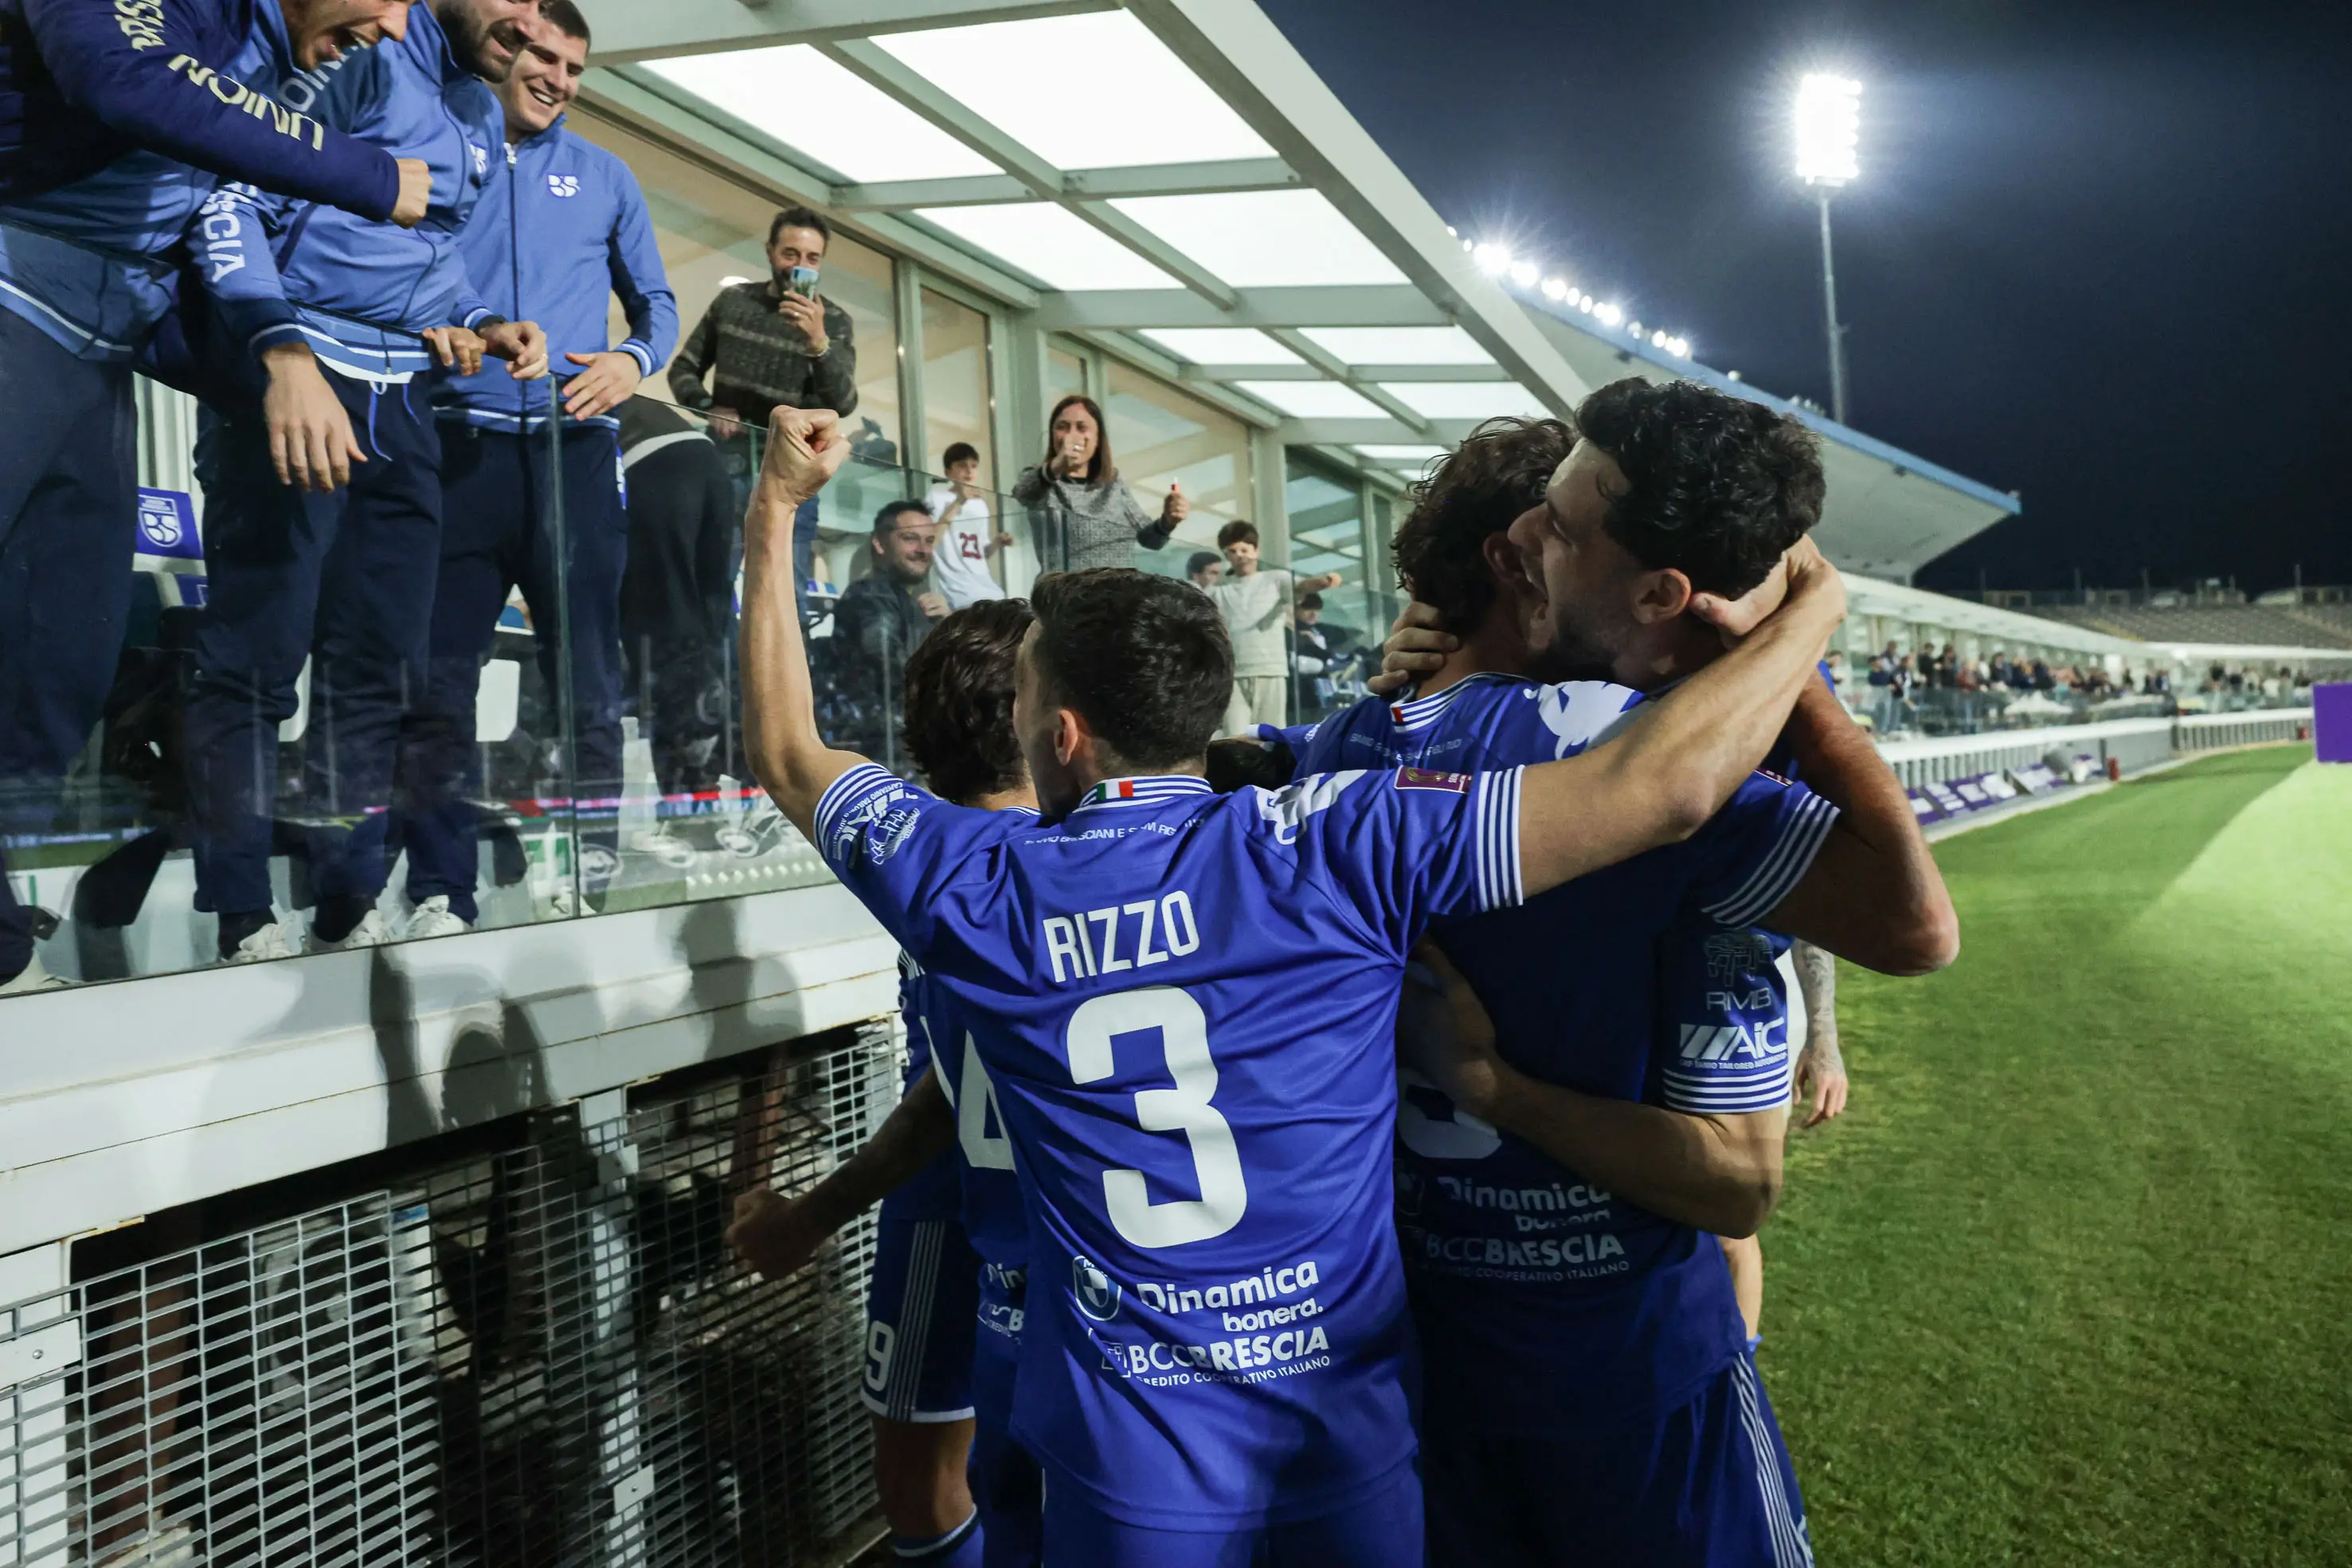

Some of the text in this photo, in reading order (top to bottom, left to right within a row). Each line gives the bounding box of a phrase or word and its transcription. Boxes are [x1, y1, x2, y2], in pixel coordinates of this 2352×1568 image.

[166, 53, 324, 151] UNION
[1043, 890, 1200, 983] RIZZO
[1706, 987, 1772, 1011] RMB
[1066, 985, 1247, 1249] 3
[1137, 1261, 1320, 1314] Dinamica
[1567, 1260, 1630, 1281] ITALIANO
[865, 1320, 895, 1392] 9
[1129, 1326, 1330, 1374] BCCBRESCIA
[1279, 1355, 1331, 1378] ITALIANO
